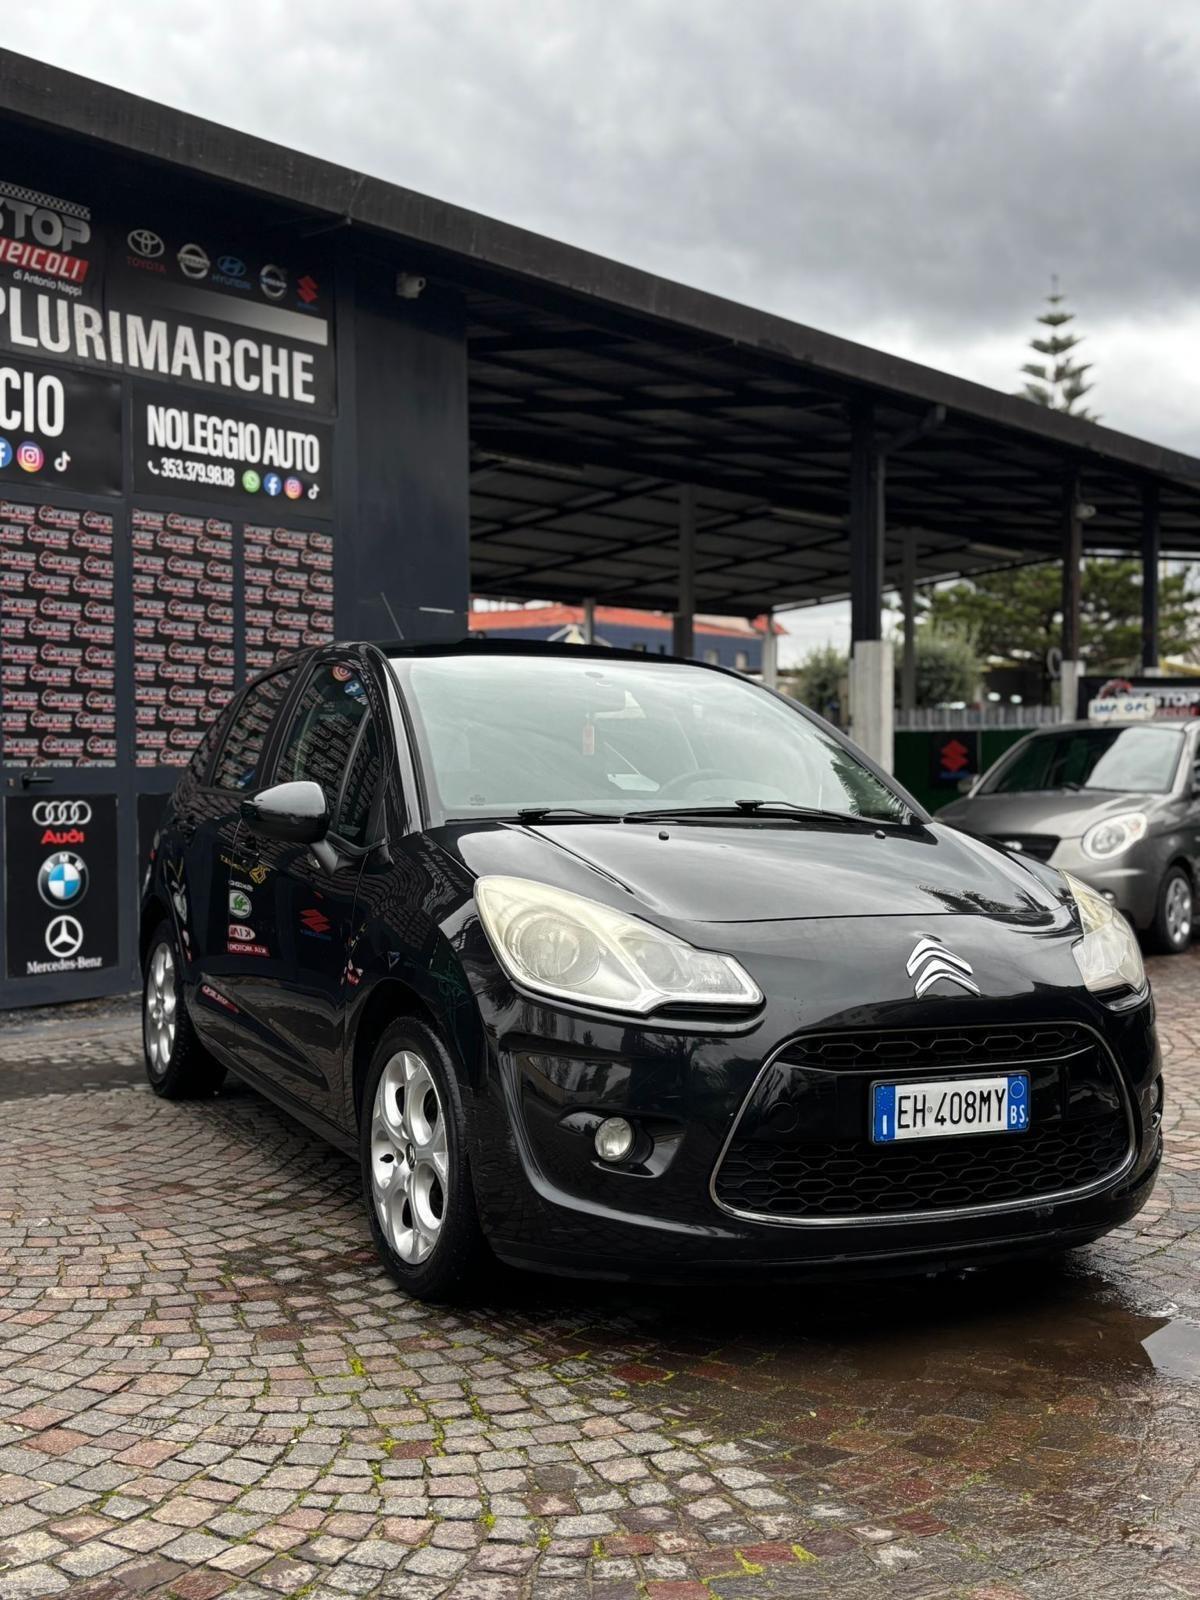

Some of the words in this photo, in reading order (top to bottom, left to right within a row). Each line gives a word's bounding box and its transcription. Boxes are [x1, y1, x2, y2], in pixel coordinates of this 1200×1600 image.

[0, 197, 91, 252] TOP
[13, 269, 22, 280] di
[24, 271, 57, 289] Antonio
[57, 281, 82, 297] Nappi
[0, 286, 315, 404] LURIMARCHE
[147, 404, 261, 464] NOLEGGIO
[262, 427, 320, 474] AUTO
[160, 457, 236, 488] 353.379.98.18
[41, 828, 85, 844] Audi
[26, 956, 103, 975] Mercedes-Benz
[897, 1094, 927, 1129] EH
[934, 1088, 1006, 1126] 408MY
[1010, 1104, 1025, 1124] BS
